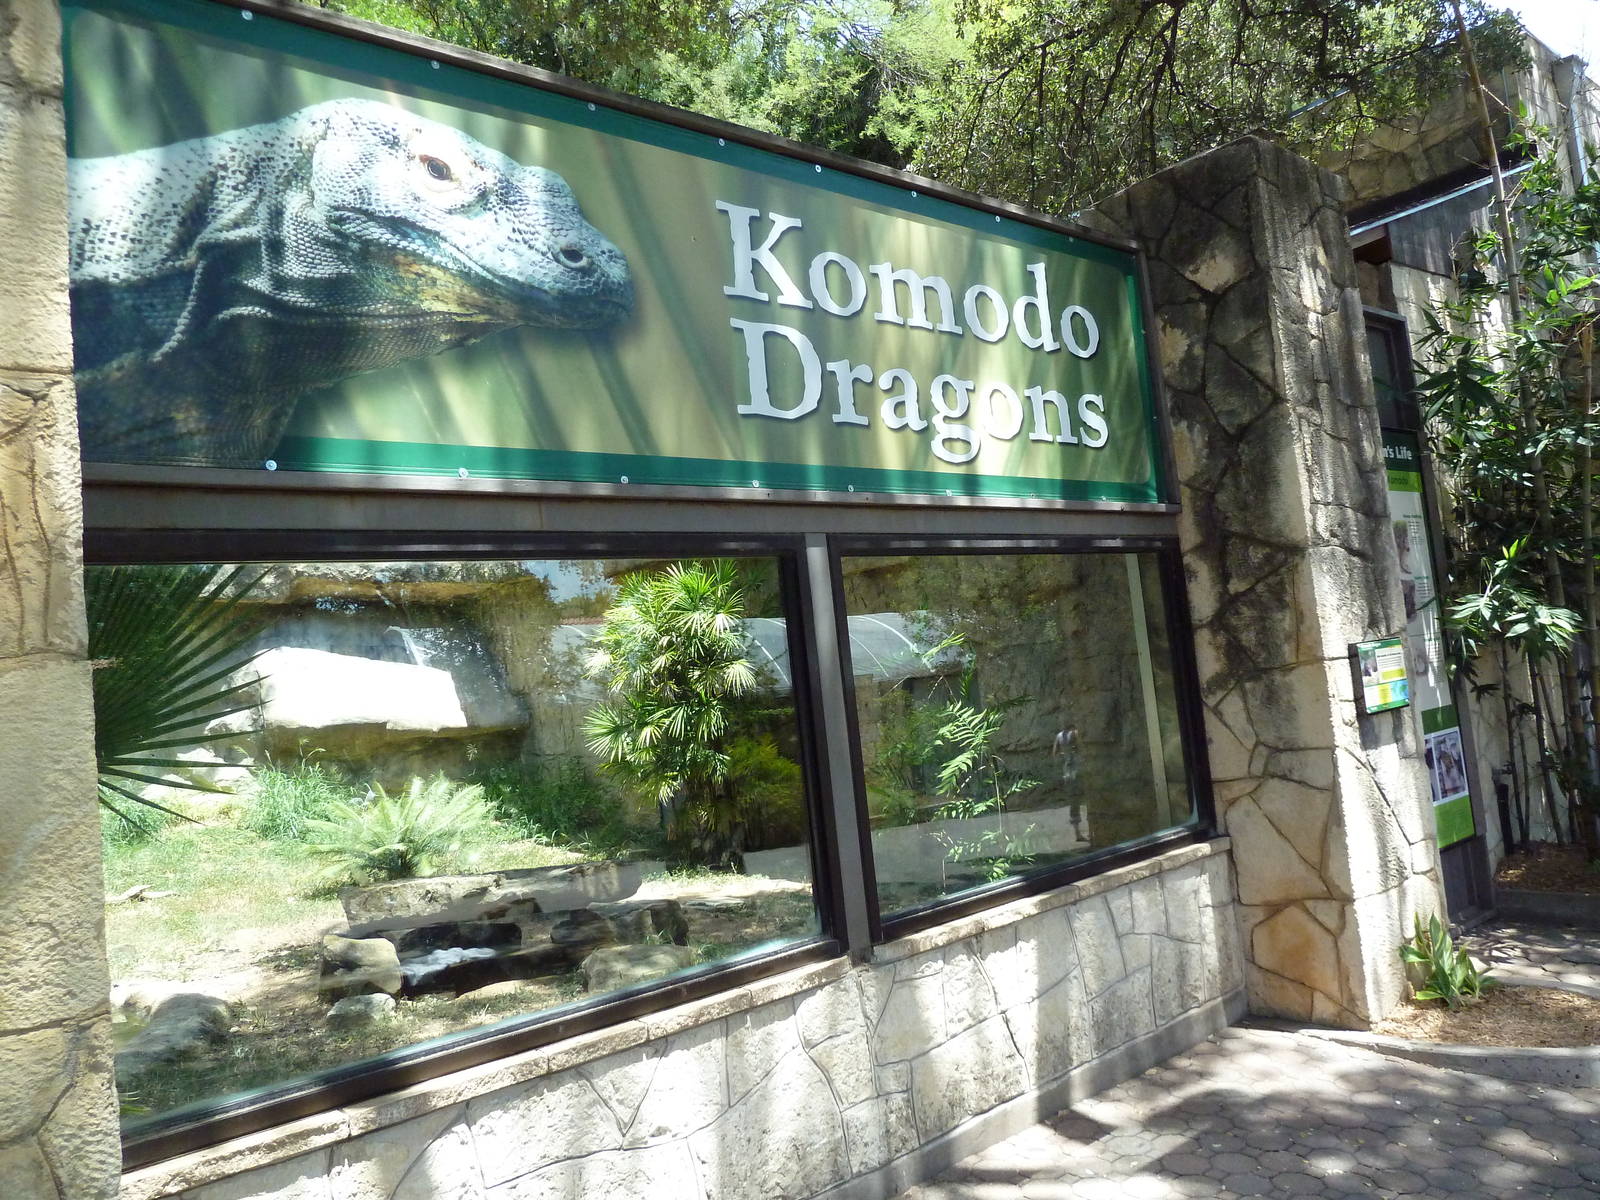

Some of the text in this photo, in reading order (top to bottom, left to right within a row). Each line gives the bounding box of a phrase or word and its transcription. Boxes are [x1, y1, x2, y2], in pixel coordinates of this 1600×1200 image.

[715, 199, 1100, 359] Komodo
[730, 317, 1109, 464] Dragons
[1395, 446, 1412, 460] Life
